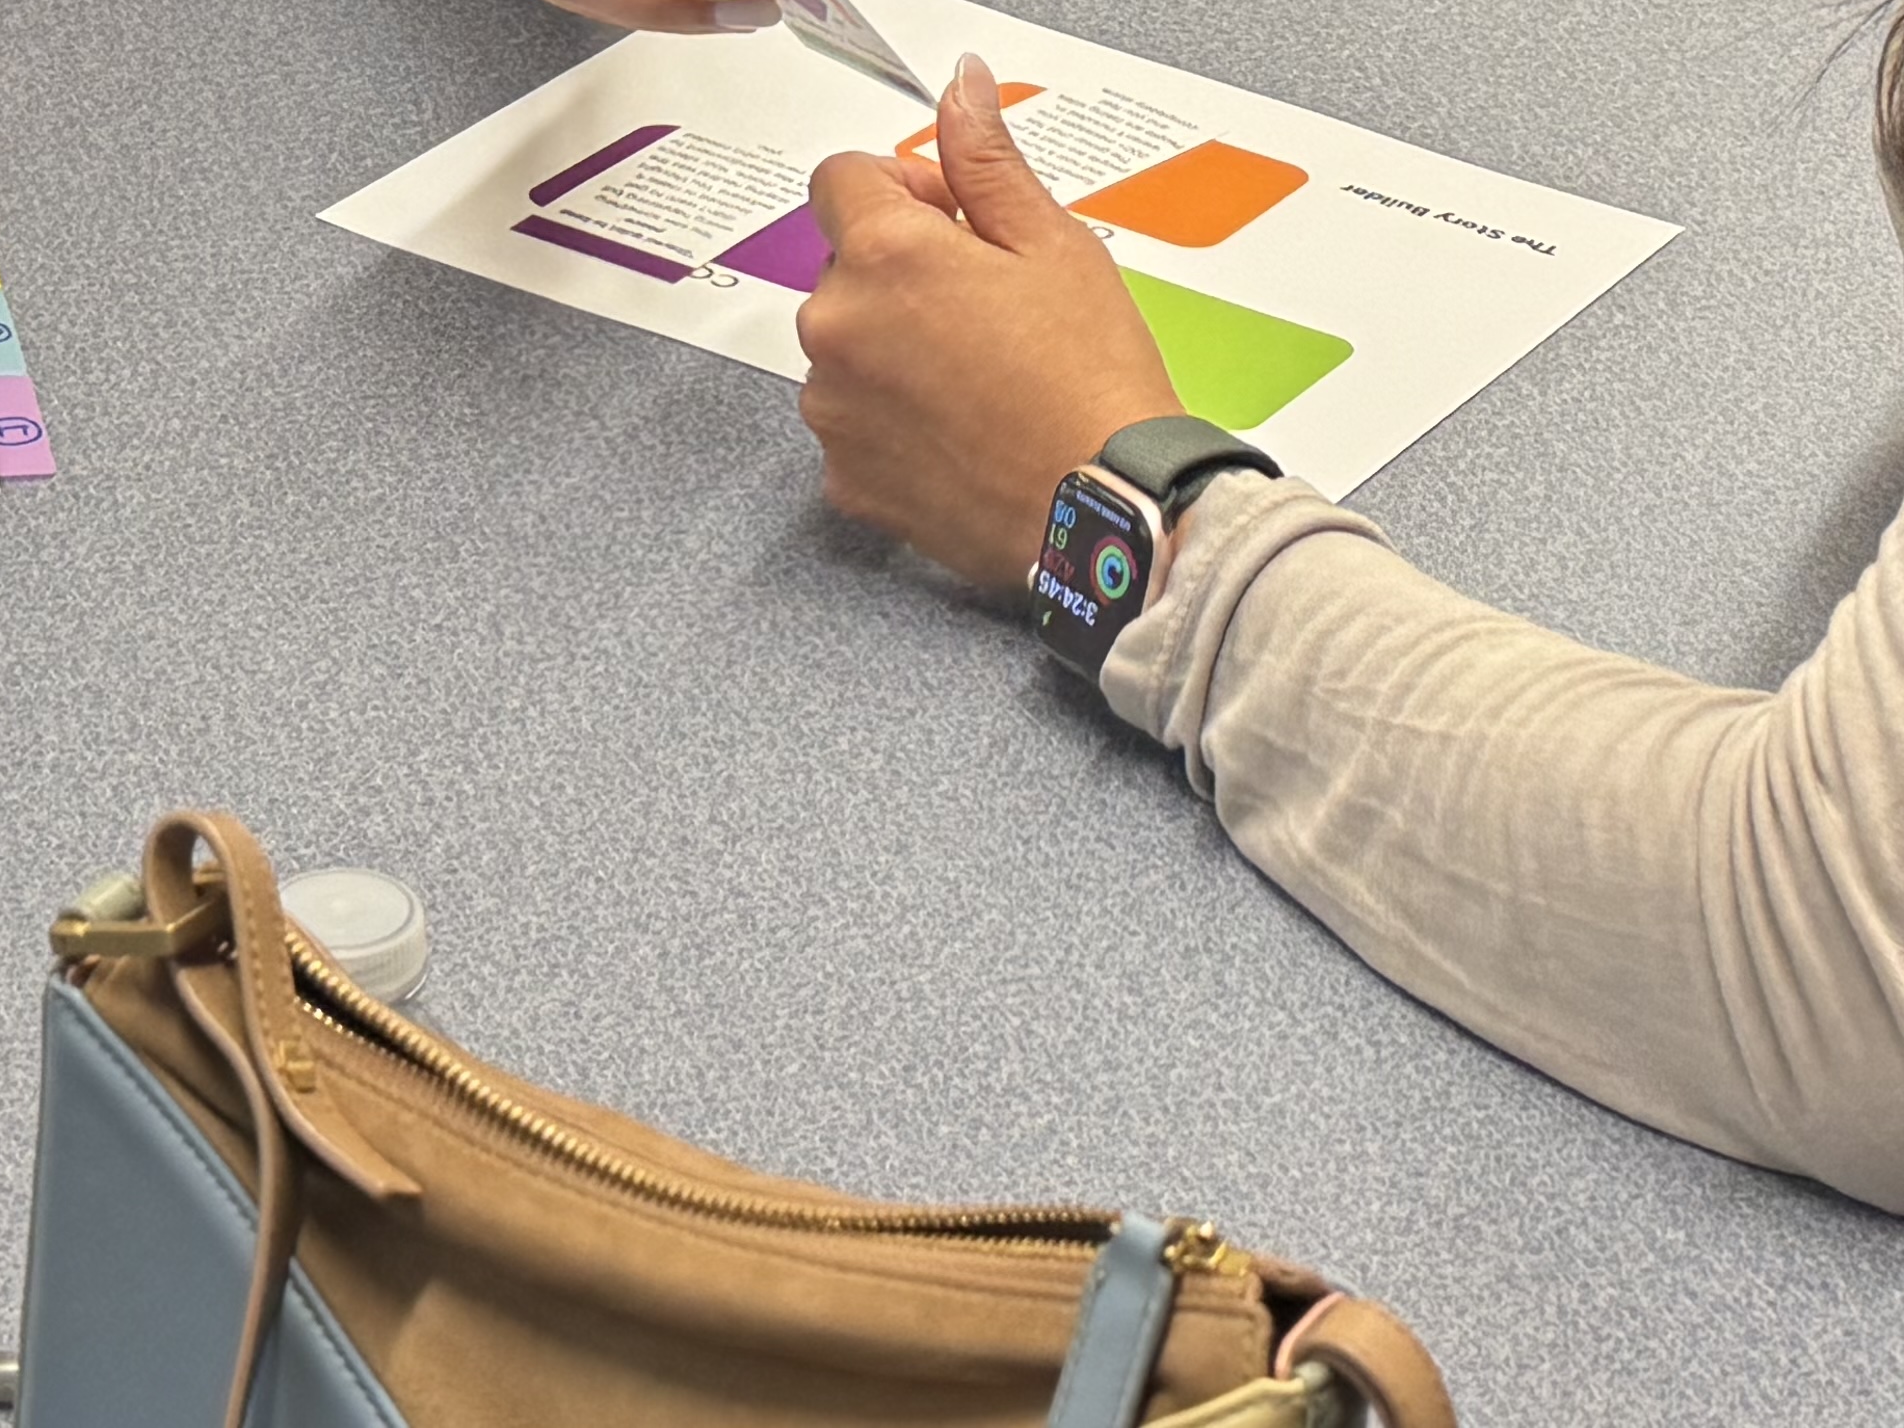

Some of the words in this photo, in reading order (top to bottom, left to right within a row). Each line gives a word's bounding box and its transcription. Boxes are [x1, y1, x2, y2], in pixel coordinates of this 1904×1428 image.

[1340, 184, 1430, 218] Builder
[1433, 212, 1506, 240] Story
[1511, 235, 1557, 257] The
